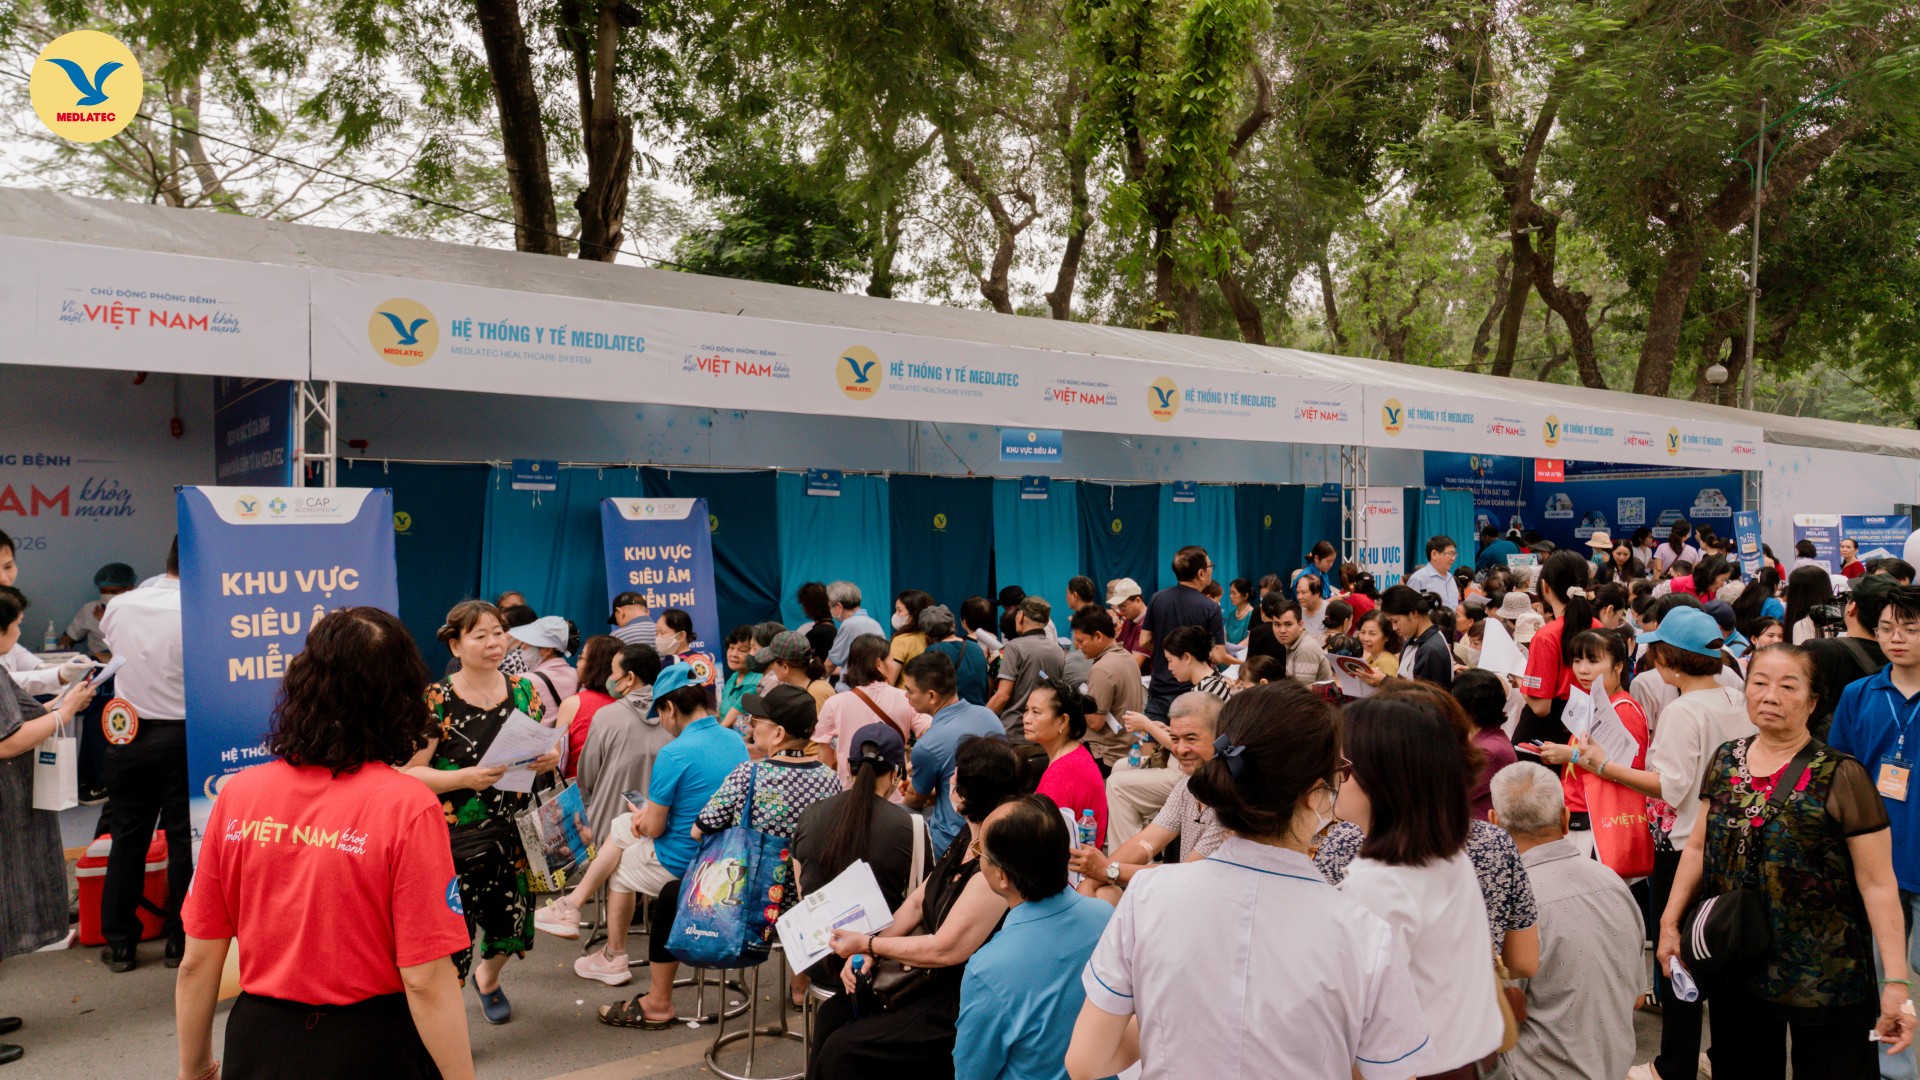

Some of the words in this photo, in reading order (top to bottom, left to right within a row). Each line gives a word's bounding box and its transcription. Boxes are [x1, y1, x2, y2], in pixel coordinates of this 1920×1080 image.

[90, 287, 113, 296] CHỦ
[116, 289, 147, 299] ĐỘNG
[150, 292, 186, 302] PHÒNG
[189, 295, 216, 305] BỆNH
[59, 312, 85, 325] một
[83, 301, 141, 330] VIỆT
[150, 310, 209, 331] NAM
[451, 317, 473, 342] HỆ
[477, 318, 531, 343] THỐNG
[535, 327, 545, 344] Y
[548, 324, 568, 346] TẾ
[571, 330, 646, 353] MEDLATEC
[383, 347, 424, 357] MEDLATEC
[450, 346, 499, 358] MEDLATEC
[500, 350, 556, 362] HEALTHCARE
[558, 354, 592, 364] SYSTEM
[696, 355, 731, 378] VIỆT
[735, 361, 771, 377] NAM
[890, 360, 904, 381] HỆ
[907, 360, 942, 380] THỐNG
[945, 368, 952, 381] Y
[955, 364, 967, 383] TẾ
[969, 370, 1020, 387] MEDLATEC
[1053, 387, 1077, 406] VIỆT
[1080, 392, 1105, 405] NAM
[1185, 388, 1195, 404] HỆ
[1197, 389, 1222, 404] THỐNG
[1223, 393, 1229, 404] Y
[1230, 391, 1239, 405] TẾ
[1241, 394, 1277, 408] MEDLATEC
[1301, 406, 1318, 422] VIỆT
[1320, 410, 1339, 421] NAM
[1416, 407, 1435, 421] THỐNG
[1448, 413, 1475, 424] MEDLATEC
[1491, 422, 1504, 436] VIỆT
[1505, 428, 1520, 436] NAM
[1019, 446, 1033, 455] VỰC
[1033, 446, 1047, 455] SIÊU
[1047, 446, 1057, 455] ÂM
[22, 453, 71, 468] BỆNH
[0, 483, 71, 517] AM
[74, 495, 136, 522] mạnh
[306, 497, 330, 508] CAP
[11, 536, 47, 551] 026
[624, 545, 657, 561] KHU
[659, 543, 692, 563] VỰC
[1359, 546, 1379, 565] KHU
[1382, 545, 1401, 568] VỰC
[221, 569, 288, 596] KHU
[294, 565, 360, 599] VỰC
[629, 566, 664, 585] SIÊU
[667, 565, 691, 584] ÂM
[669, 587, 695, 607] PHÍ
[230, 606, 301, 639] SIÊU
[221, 747, 239, 763] HỆ
[227, 818, 238, 833] Vì
[1610, 812, 1634, 828] VIỆT
[242, 815, 288, 848] VIỆT
[292, 825, 340, 849] NAM
[336, 841, 367, 855] mạnh
[684, 923, 719, 940] Wegmans
